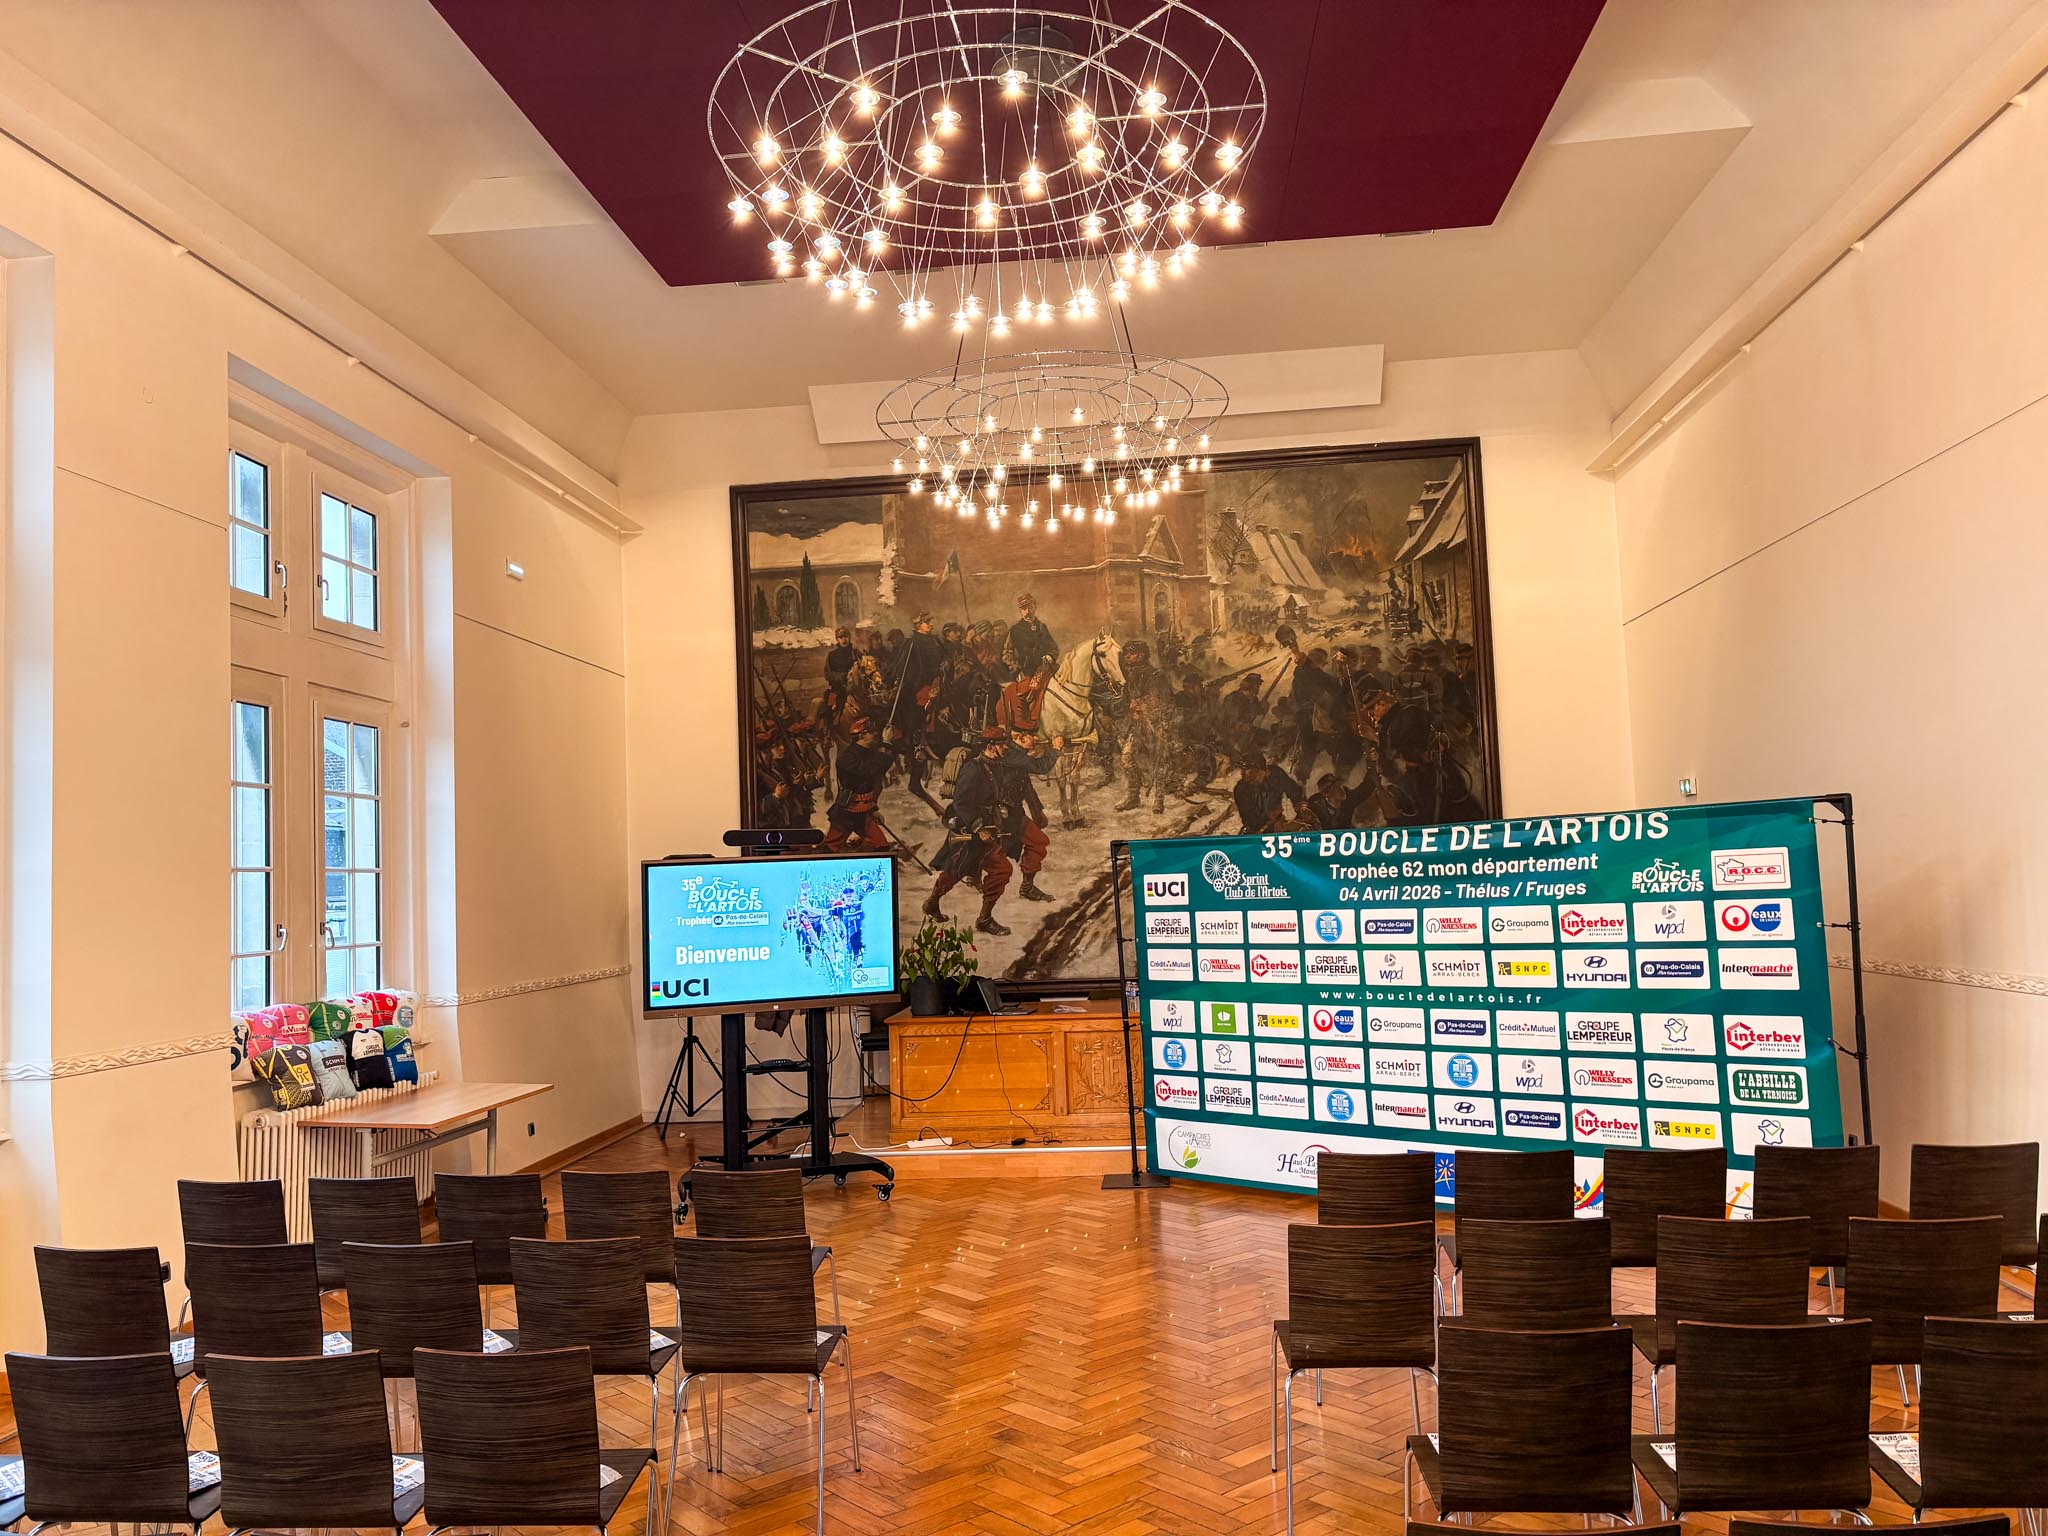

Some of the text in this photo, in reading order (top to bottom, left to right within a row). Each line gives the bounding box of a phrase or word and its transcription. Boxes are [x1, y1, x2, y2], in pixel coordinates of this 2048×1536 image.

[1319, 828, 1439, 857] BOUCLE
[1450, 823, 1492, 850] DE
[1503, 812, 1669, 848] L'ARTOIS
[1329, 853, 1598, 882] Trophée 62 mon département
[1728, 866, 1780, 876] R.O.C.C.
[1241, 873, 1269, 885] Sprint
[1632, 868, 1701, 884] BOUCLE
[1154, 881, 1185, 897] UCI
[1224, 885, 1287, 897] Club de l'Artois
[1339, 887, 1359, 901] 04
[1362, 885, 1399, 901] Avril
[1401, 884, 1441, 900] 2026
[1456, 882, 1510, 899] Thélus
[1513, 881, 1523, 897] /
[1525, 880, 1587, 900] Fruges
[1640, 878, 1704, 894] L'ARTOIS
[688, 886, 760, 902] BOUCLE
[1752, 910, 1781, 919] eaux
[676, 916, 711, 927] Trophée
[1154, 918, 1182, 926] GROUPE
[1506, 920, 1550, 928] Groupama
[1567, 917, 1625, 928] interbev
[1147, 926, 1190, 935] LEMPEREUR
[1655, 918, 1685, 938] wpd
[675, 945, 771, 966] Bienvenue
[1315, 956, 1348, 964] GROUPE
[1150, 960, 1166, 968] Crédit
[1256, 961, 1299, 970] interbev
[1307, 965, 1358, 974] LEMPEREUR
[1721, 964, 1794, 974] Intermarché
[1379, 966, 1403, 983] wpd
[1567, 973, 1627, 982] HYUNDAI
[662, 978, 709, 999] UCI
[1320, 991, 1542, 1004] www.boucledelartois.fr
[1163, 1015, 1182, 1030] wpd
[1334, 1014, 1354, 1022] eaux
[1383, 1020, 1422, 1029] Groupama
[1499, 1023, 1556, 1033] Crédit Mutuel
[1578, 1020, 1620, 1031] GROUPE
[1567, 1031, 1633, 1042] LEMPEREUR
[1734, 1029, 1802, 1043] interbev
[1328, 1062, 1361, 1070] NAESSENS
[1516, 1074, 1543, 1091] wpd
[1591, 1076, 1633, 1084] NAESSENS
[1665, 1076, 1715, 1086] Groupama
[1738, 1073, 1796, 1089] L'ABEILLE
[1159, 1086, 1198, 1097] interbev
[1213, 1086, 1243, 1096] GROUPE
[1740, 1089, 1798, 1100] DE LA TERNOISE
[1206, 1094, 1251, 1106] LEMPEREUR
[1259, 1093, 1277, 1101] Crédit
[1284, 1095, 1306, 1104] Mutuel
[1438, 1116, 1494, 1128] HYUNDAI
[1580, 1116, 1639, 1130] interbev
[1675, 1125, 1711, 1135] SNPC
